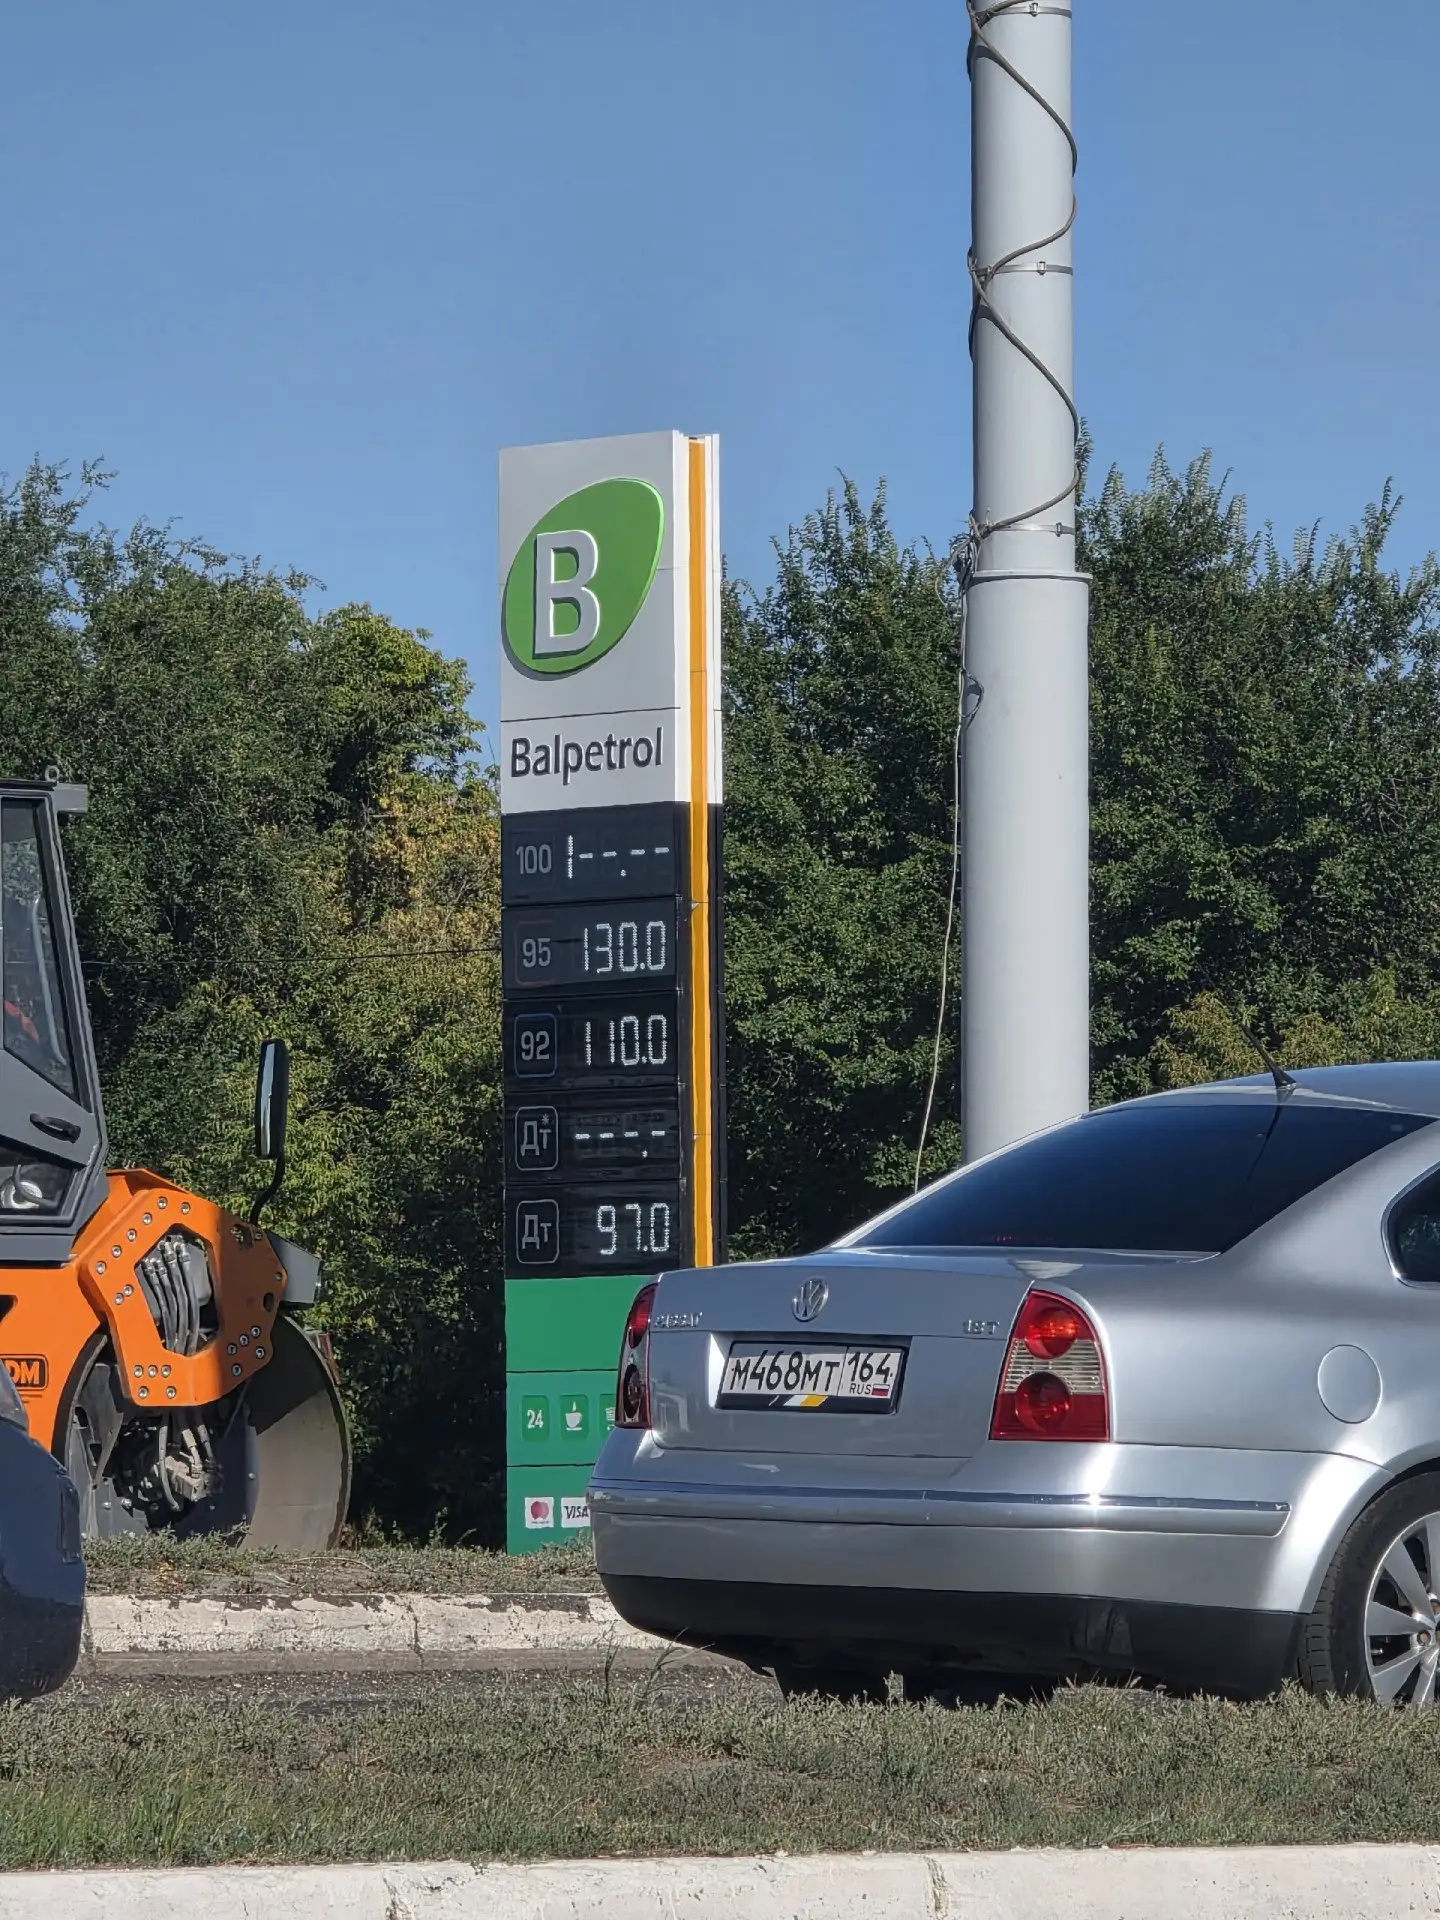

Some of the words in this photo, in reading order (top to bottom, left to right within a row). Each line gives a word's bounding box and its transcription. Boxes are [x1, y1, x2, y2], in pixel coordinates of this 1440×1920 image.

[511, 727, 663, 785] Balpetrol
[516, 844, 551, 874] 100
[522, 938, 551, 968] 95
[583, 920, 667, 973] 130.0
[520, 1031, 550, 1061] 92
[585, 1015, 667, 1066] 110.0
[597, 1202, 670, 1255] 97.0
[848, 1352, 891, 1383] 164
[850, 1382, 872, 1395] RUS
[526, 1409, 544, 1429] 24
[563, 1505, 590, 1519] VISA
